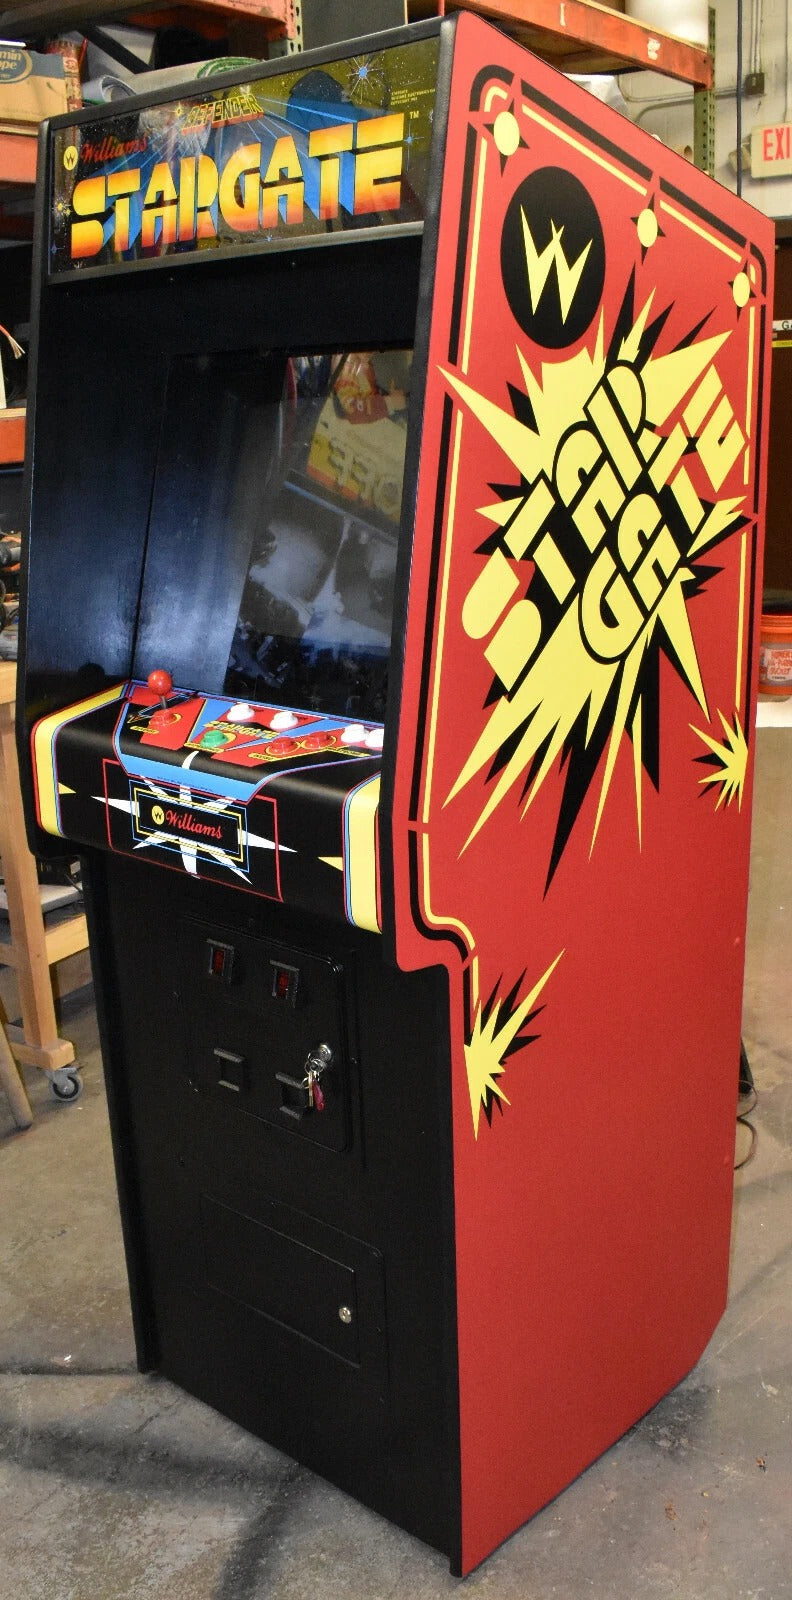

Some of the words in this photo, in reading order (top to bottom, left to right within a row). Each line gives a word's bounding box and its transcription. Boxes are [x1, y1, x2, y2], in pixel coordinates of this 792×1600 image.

[409, 110, 420, 120] TM
[80, 136, 149, 165] Williams
[70, 112, 405, 259] STARGATE
[165, 809, 223, 839] Williams
